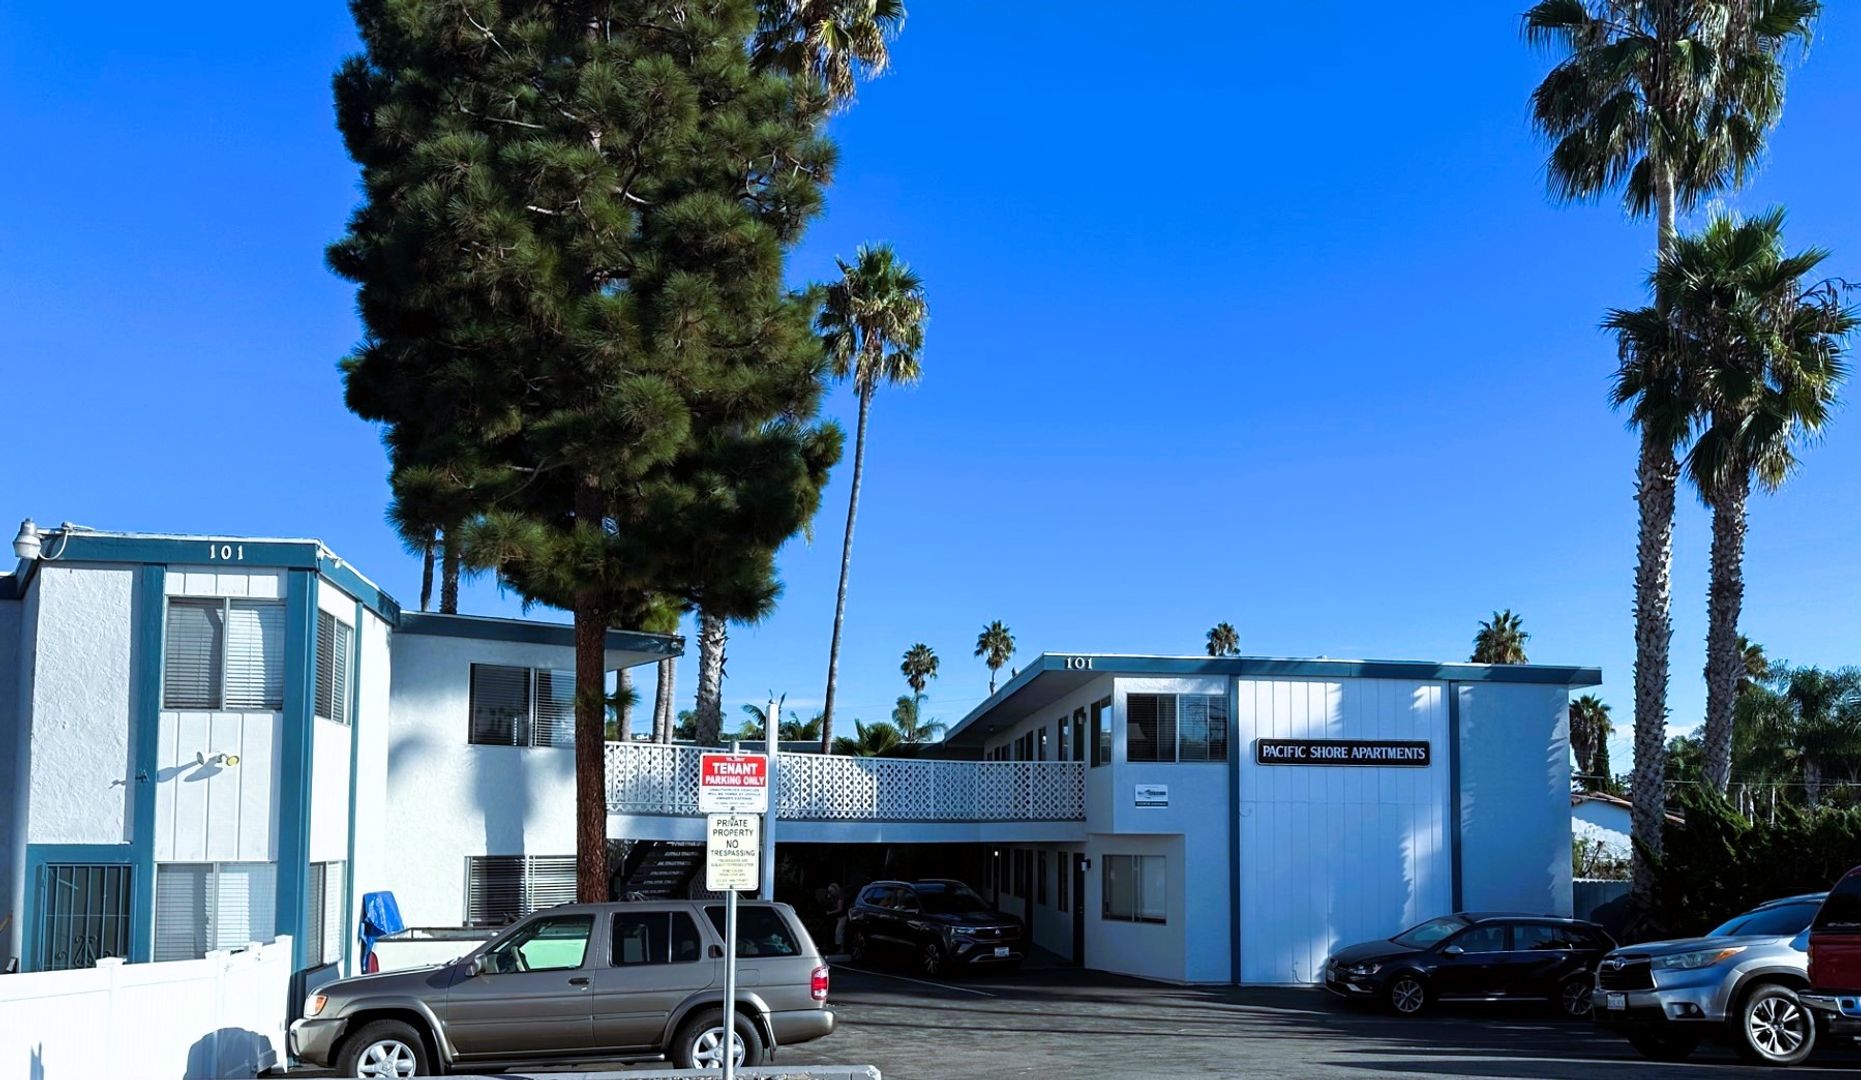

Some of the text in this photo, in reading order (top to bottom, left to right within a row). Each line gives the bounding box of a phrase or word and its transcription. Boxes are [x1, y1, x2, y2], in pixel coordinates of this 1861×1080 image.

[210, 544, 243, 560] 101
[1067, 656, 1092, 670] 101
[1262, 745, 1425, 759] PACIFIC SHORE APARTMENTS
[712, 762, 758, 775] TENANT
[705, 775, 765, 785] PARKING ONLY
[717, 819, 748, 827] PRIVATE
[712, 829, 754, 837] PROPERTY
[726, 839, 739, 848] NO
